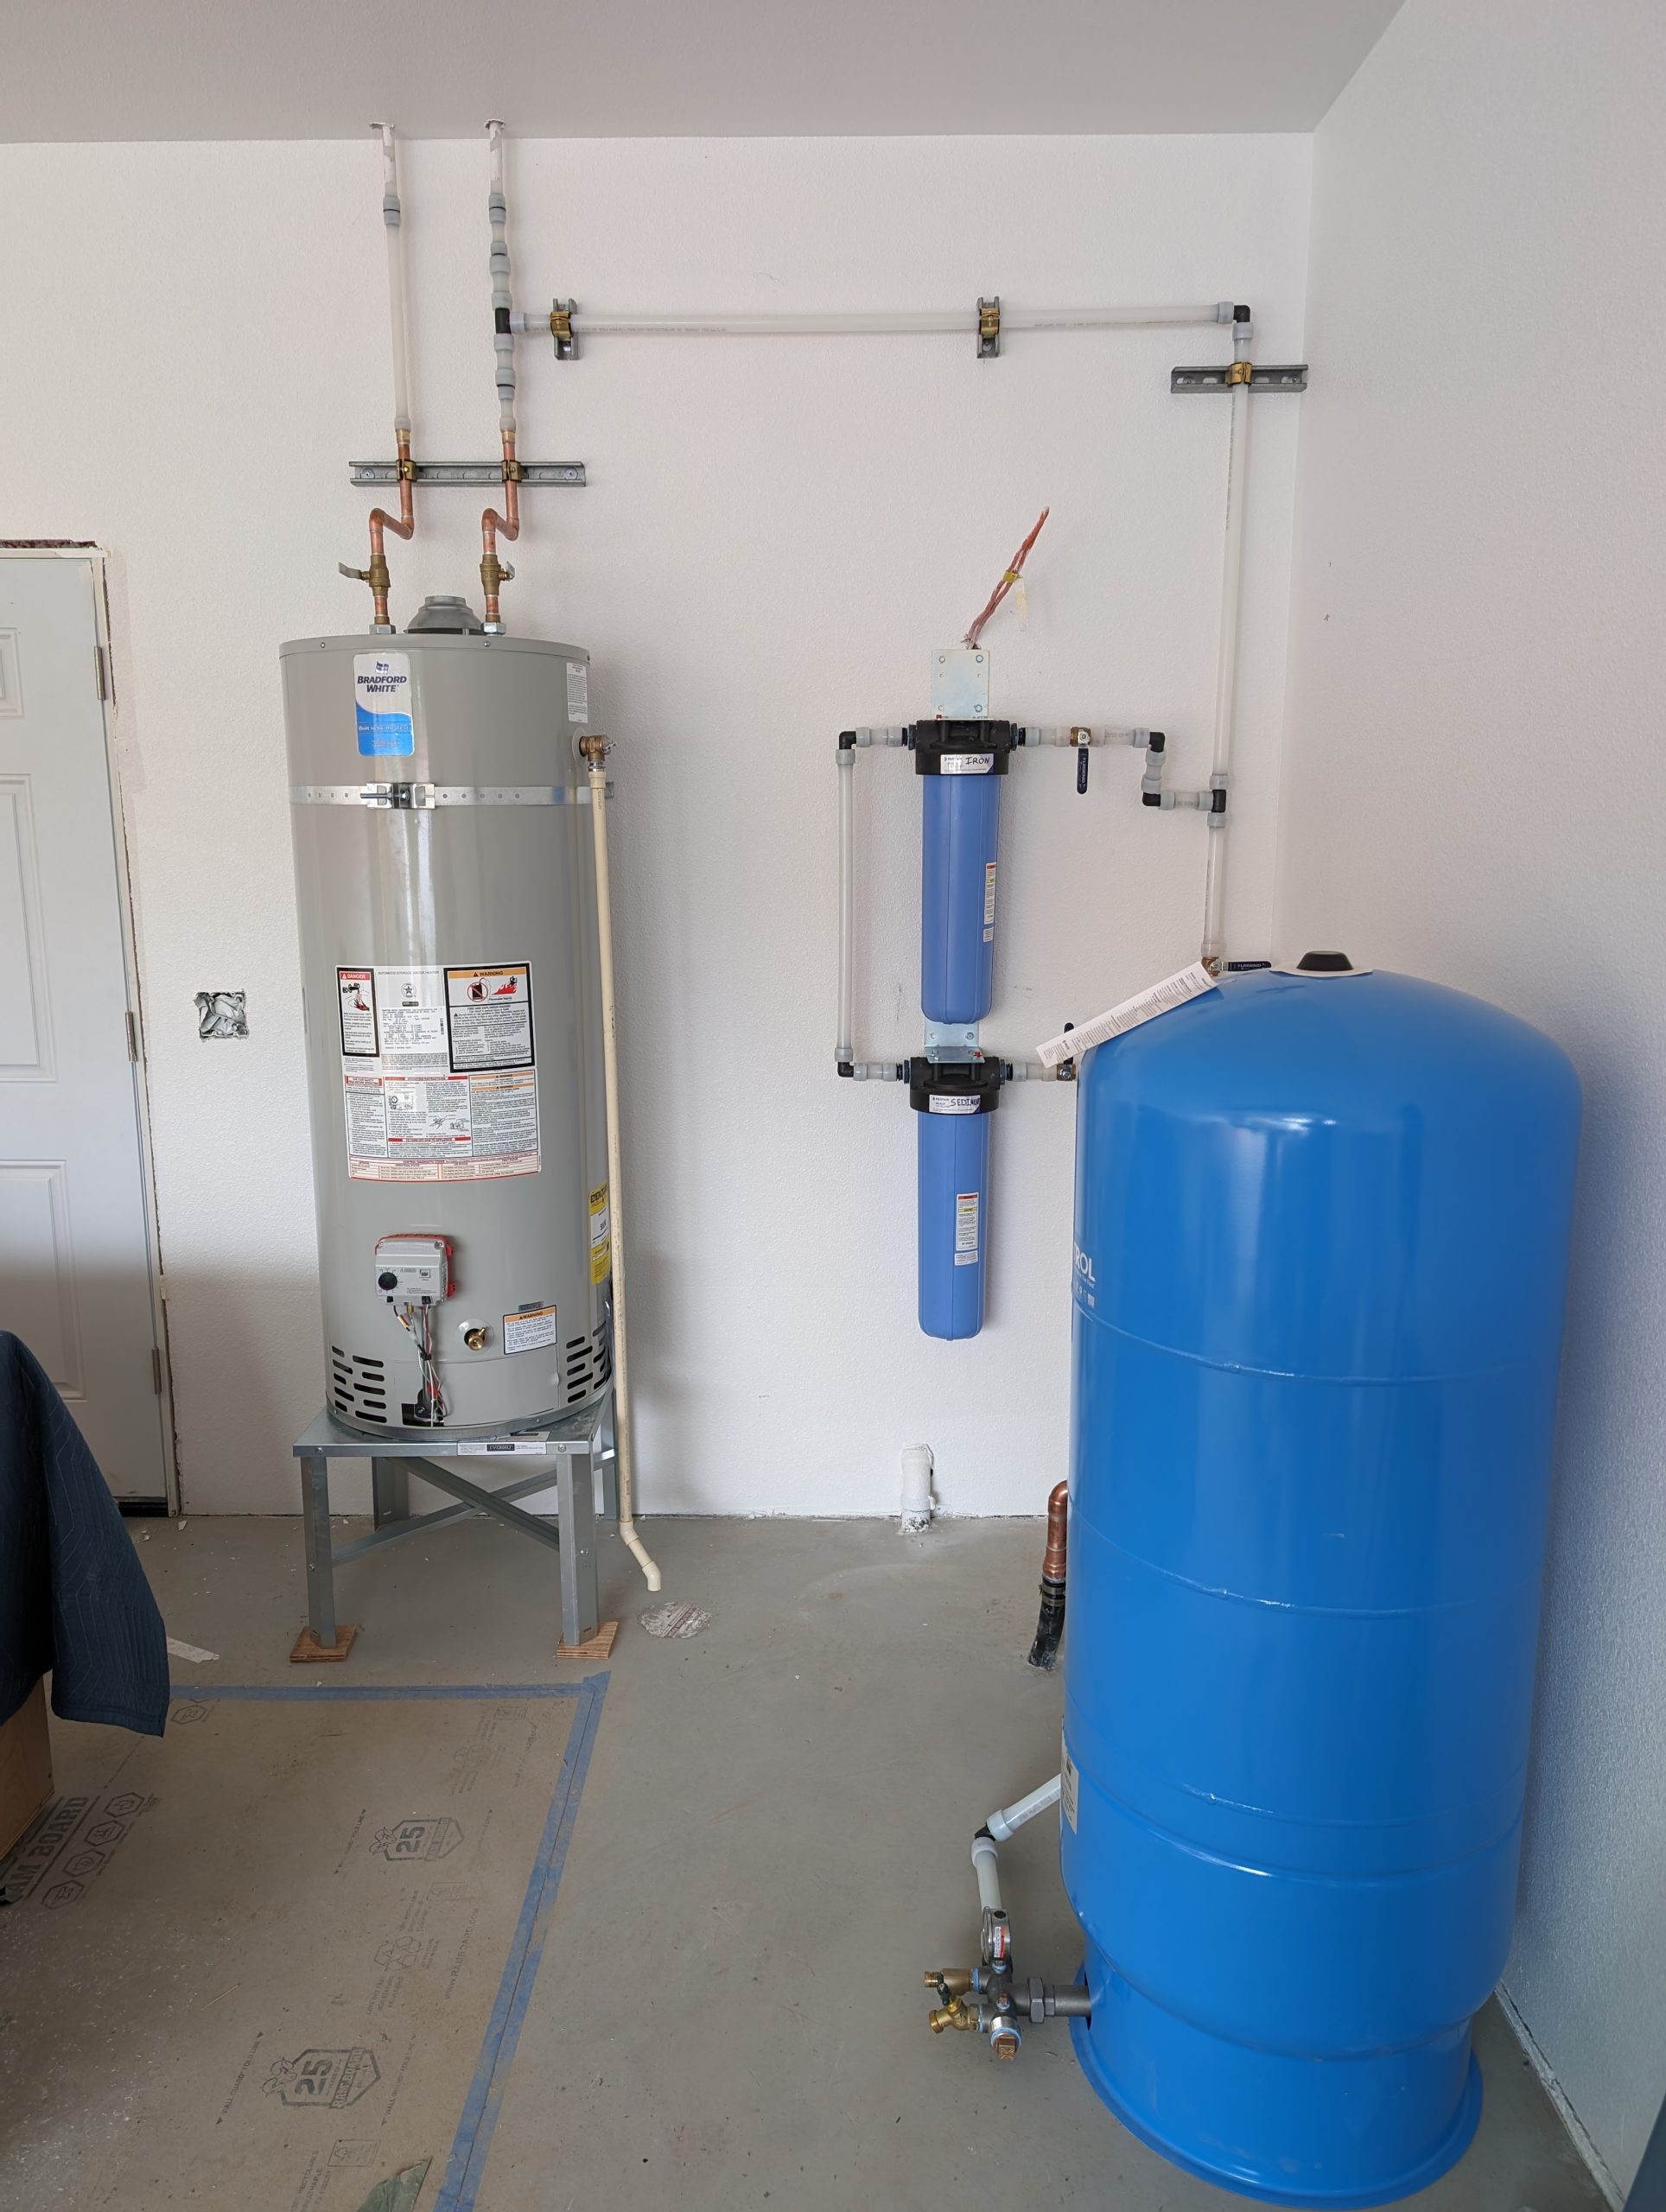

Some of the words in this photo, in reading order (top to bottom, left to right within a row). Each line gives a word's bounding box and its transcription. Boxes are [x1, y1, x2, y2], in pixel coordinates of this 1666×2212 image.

[357, 676, 407, 684] BRADFORD
[366, 684, 397, 693] WHITE
[28, 1796, 90, 1857] BOARD
[395, 1826, 426, 1853] 25
[294, 2059, 334, 2095] 25
